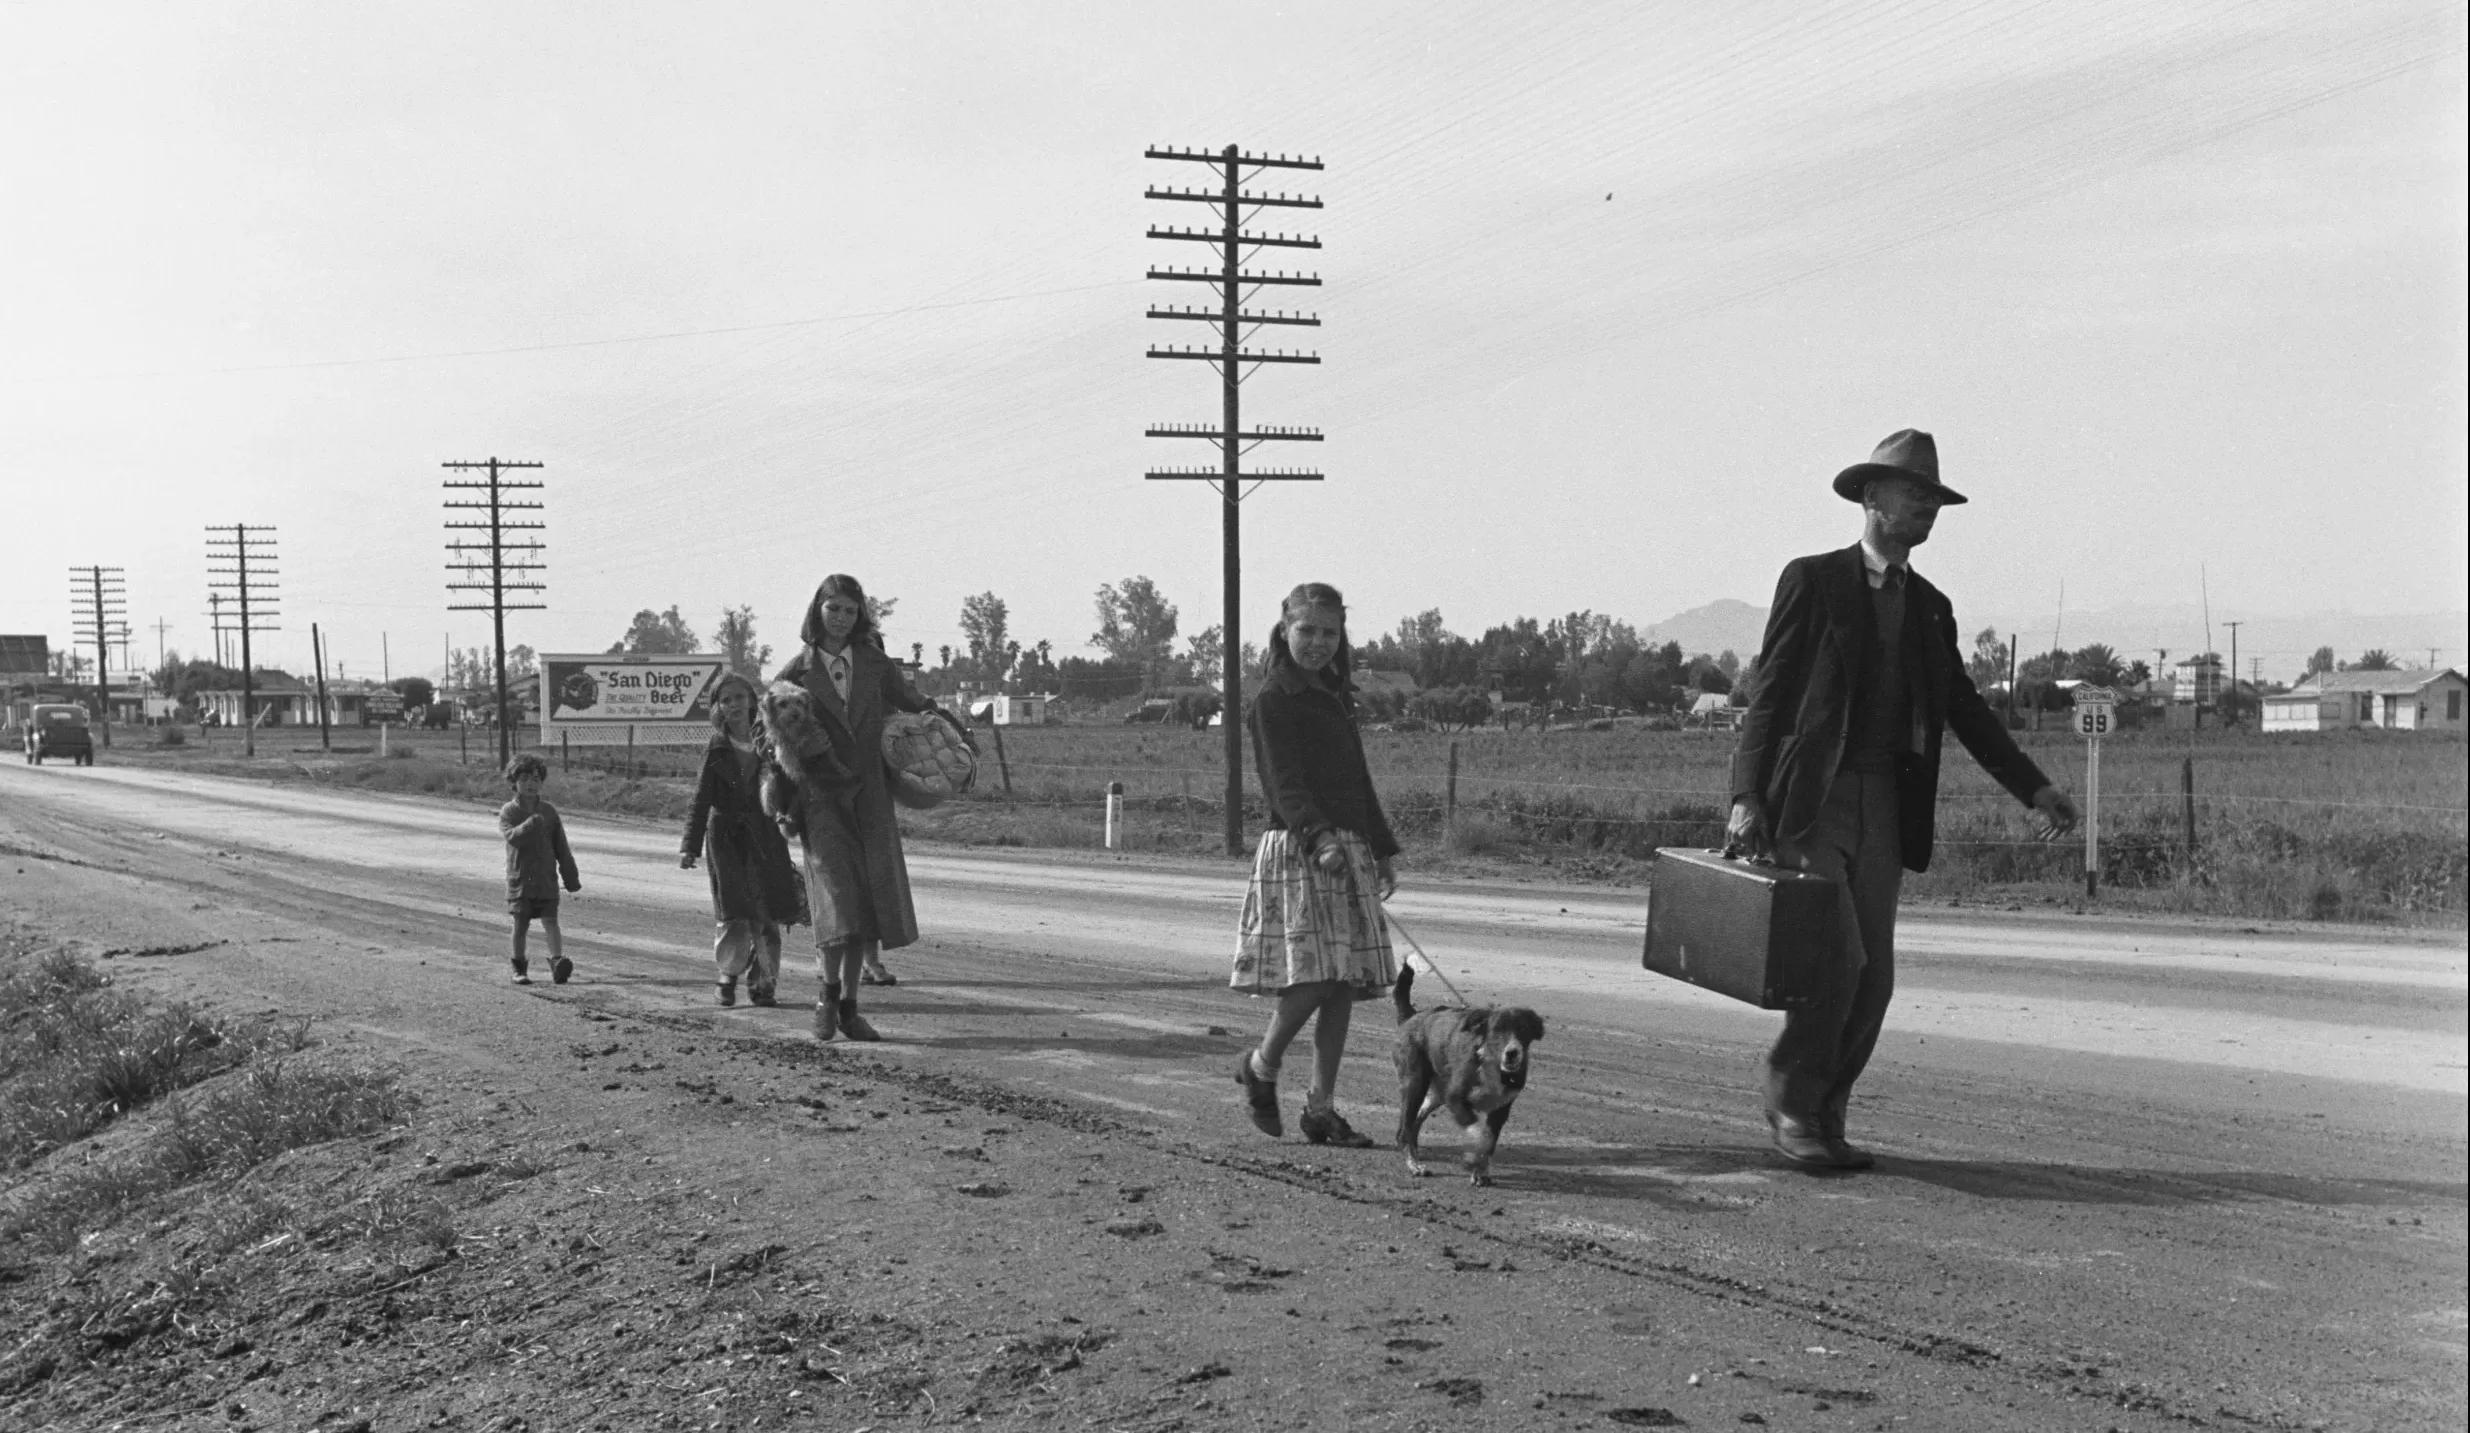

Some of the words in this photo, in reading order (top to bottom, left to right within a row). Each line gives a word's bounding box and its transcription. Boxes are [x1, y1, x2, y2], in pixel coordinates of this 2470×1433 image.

[600, 671, 641, 688] "San
[645, 671, 701, 693] Diego"
[650, 689, 686, 704] Beer
[2083, 714, 2107, 733] 99
